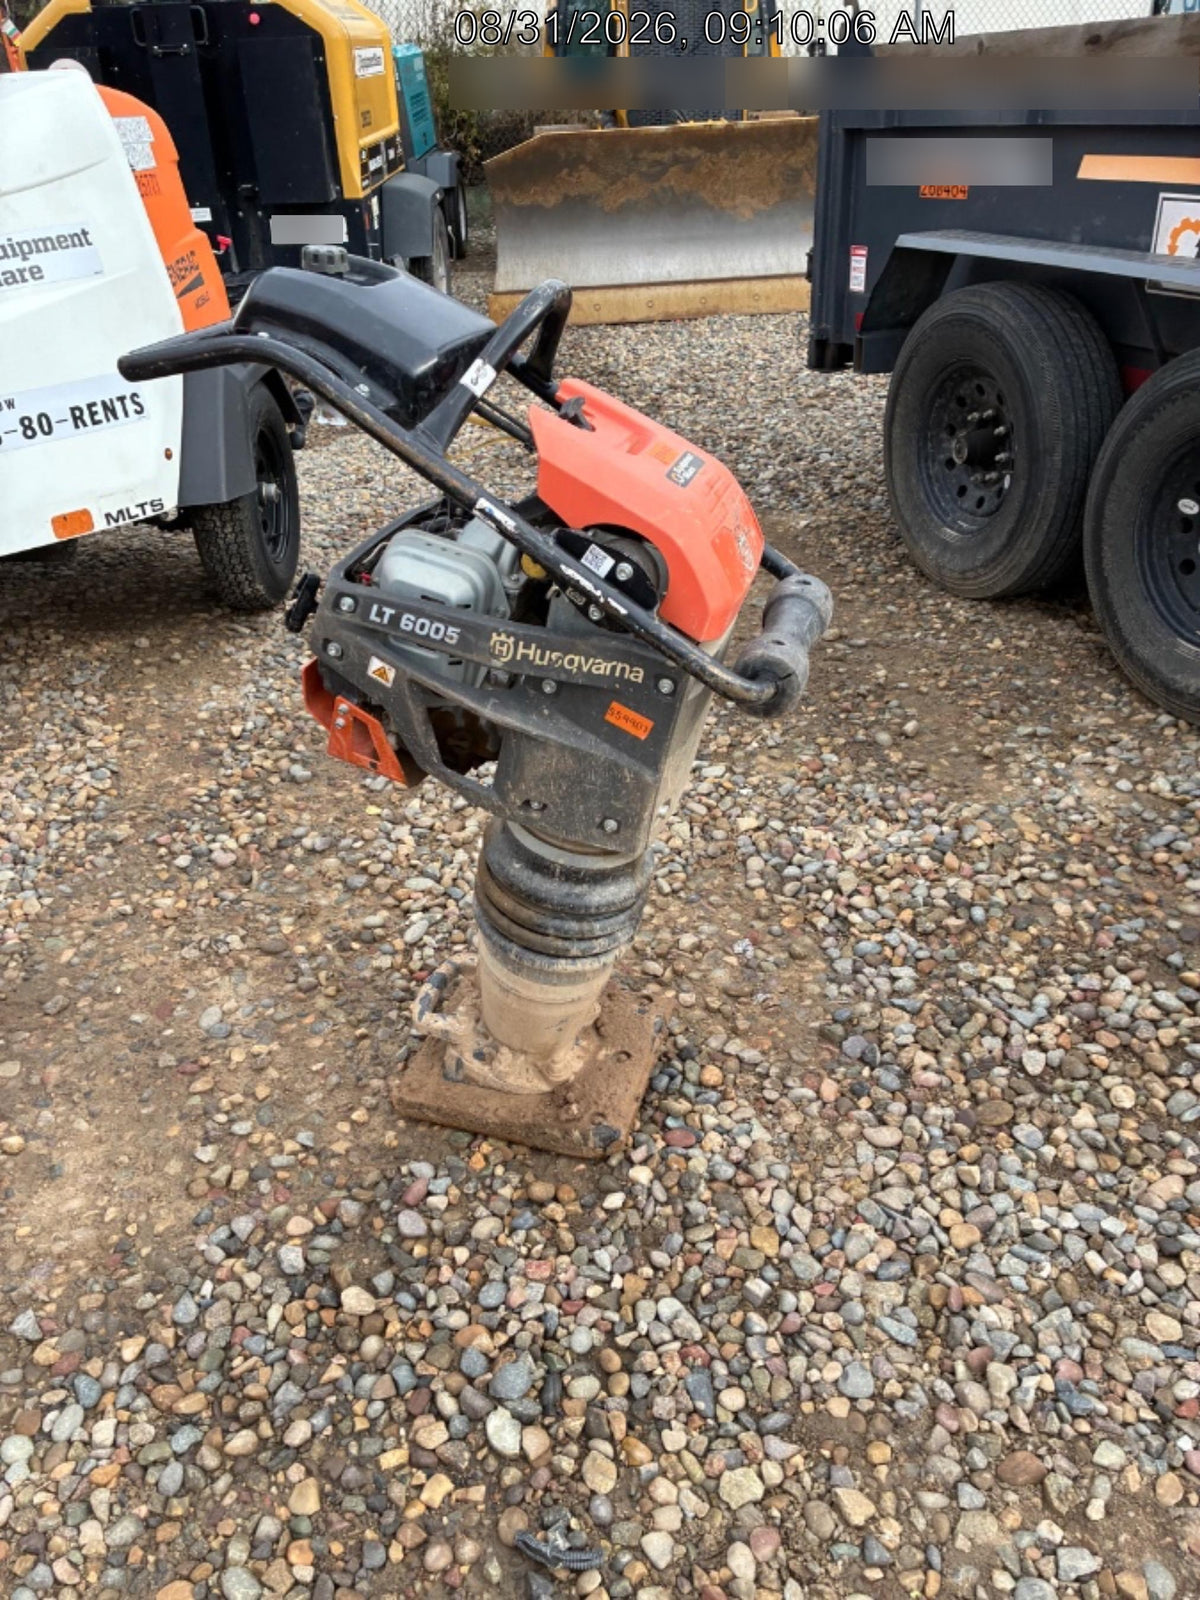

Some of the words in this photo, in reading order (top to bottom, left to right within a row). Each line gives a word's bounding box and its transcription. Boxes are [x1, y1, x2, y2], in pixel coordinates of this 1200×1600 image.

[0, 264, 44, 287] are
[0, 392, 145, 446] -80-RENTS
[104, 498, 164, 526] MLTS
[369, 604, 395, 625] LT
[400, 613, 461, 645] 6005
[516, 640, 645, 684] Husqvarna
